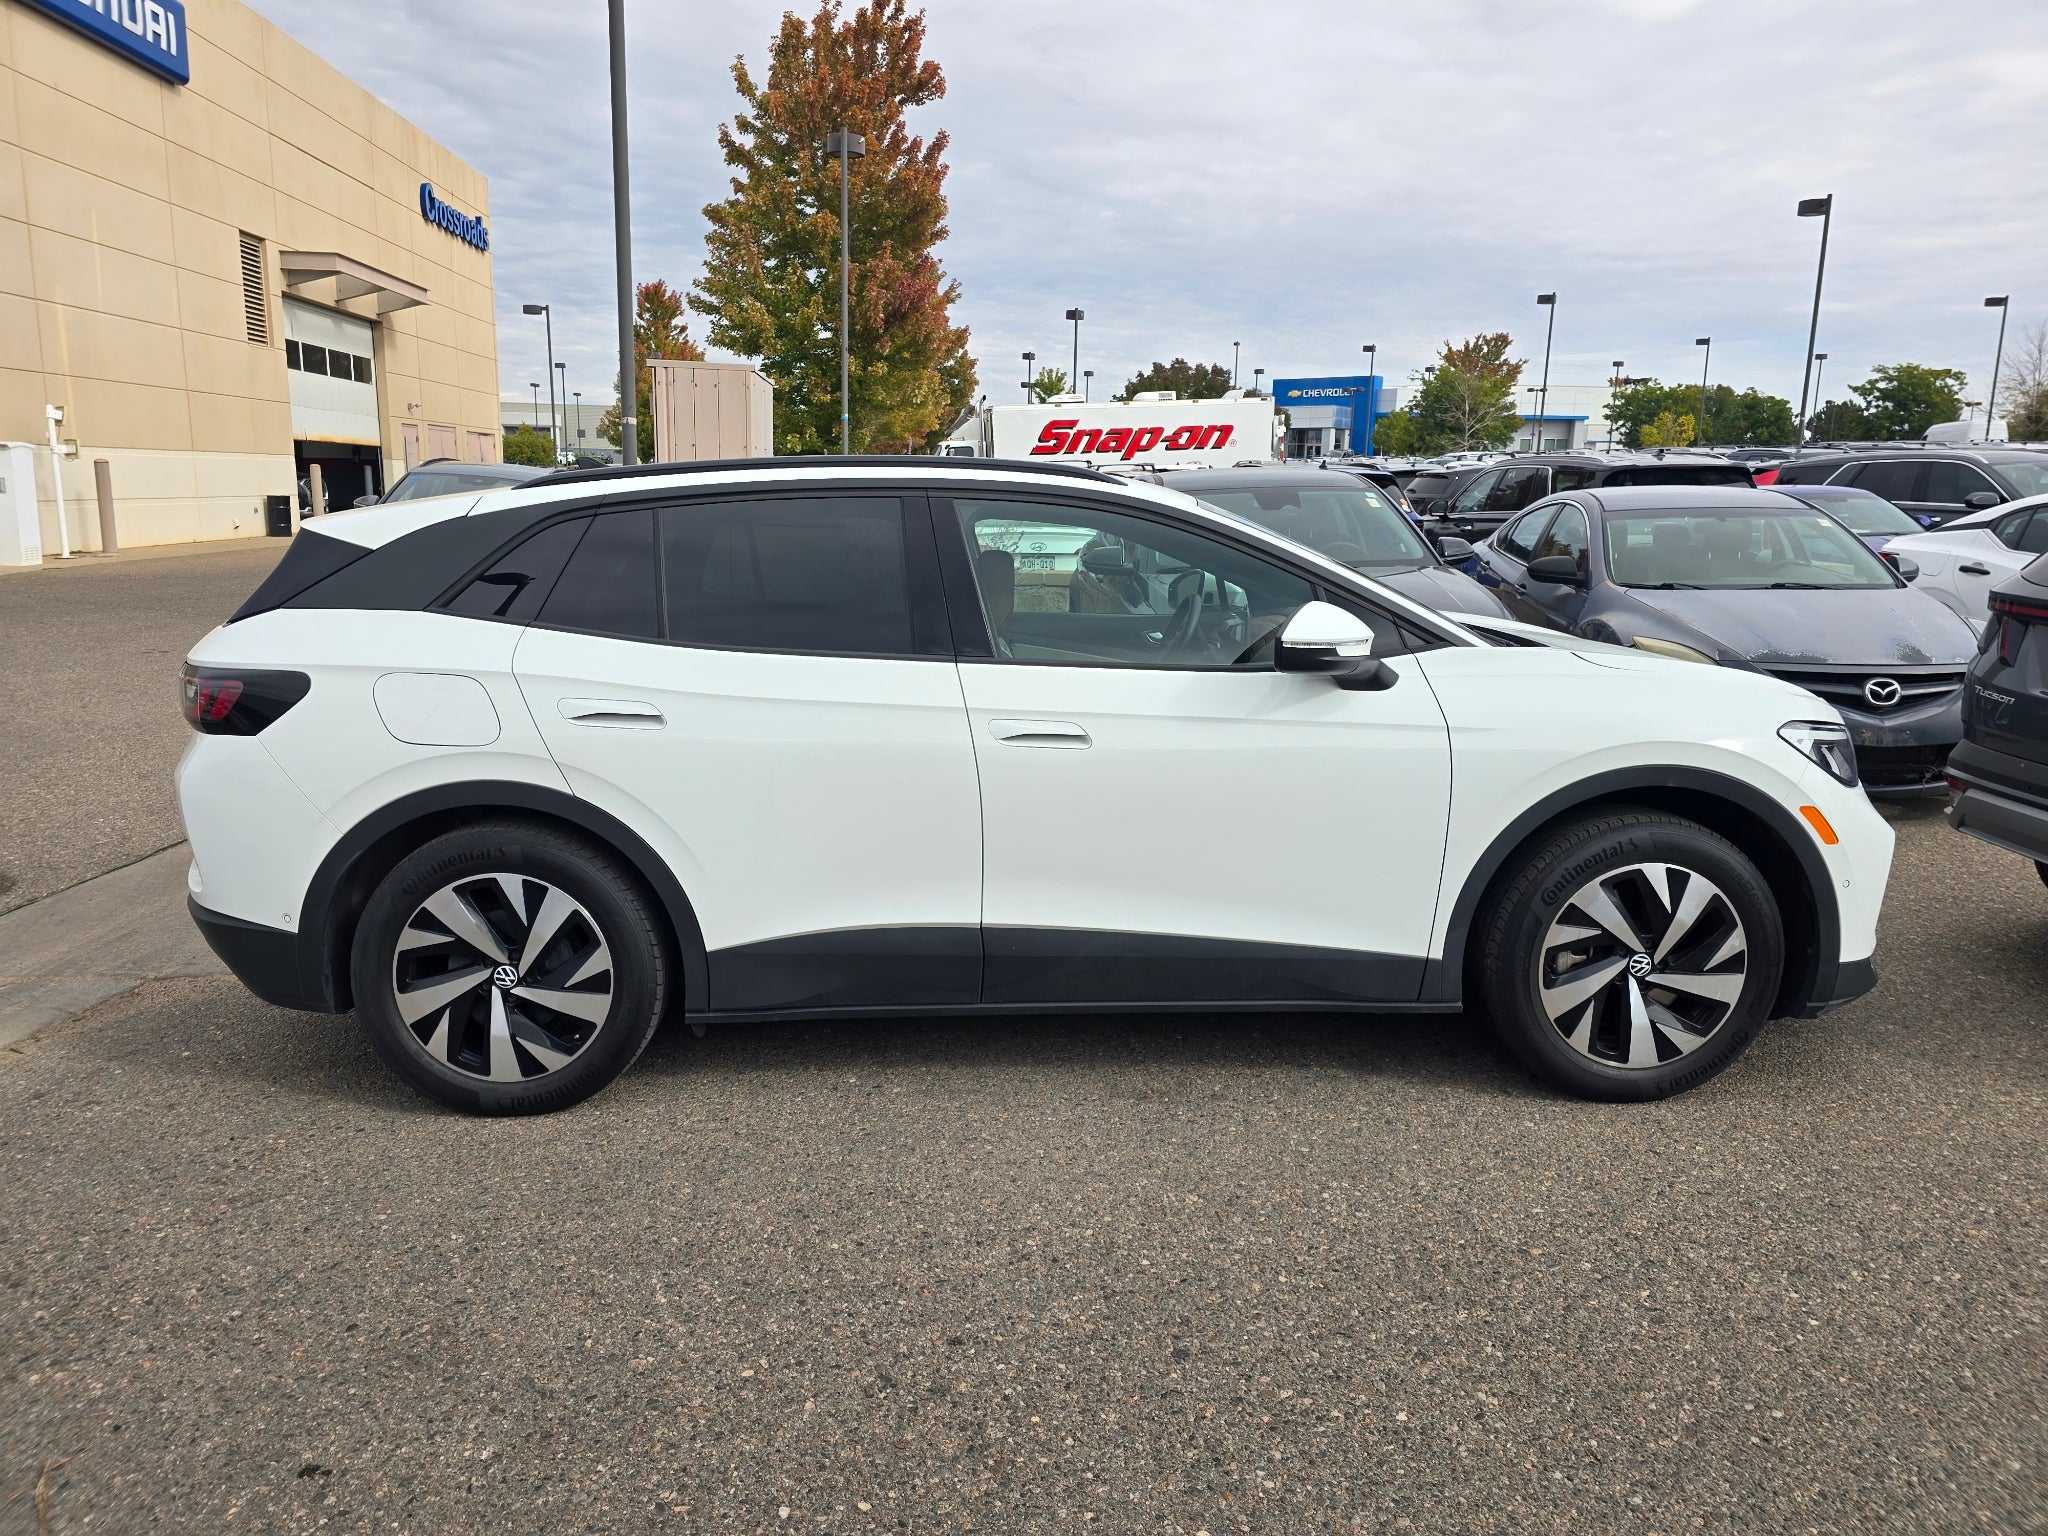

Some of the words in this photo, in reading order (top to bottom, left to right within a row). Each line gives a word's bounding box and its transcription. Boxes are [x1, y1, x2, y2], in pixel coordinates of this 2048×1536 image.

[420, 183, 489, 251] Crossroads
[1029, 419, 1234, 461] Snap-on
[1540, 841, 1624, 906] Continental
